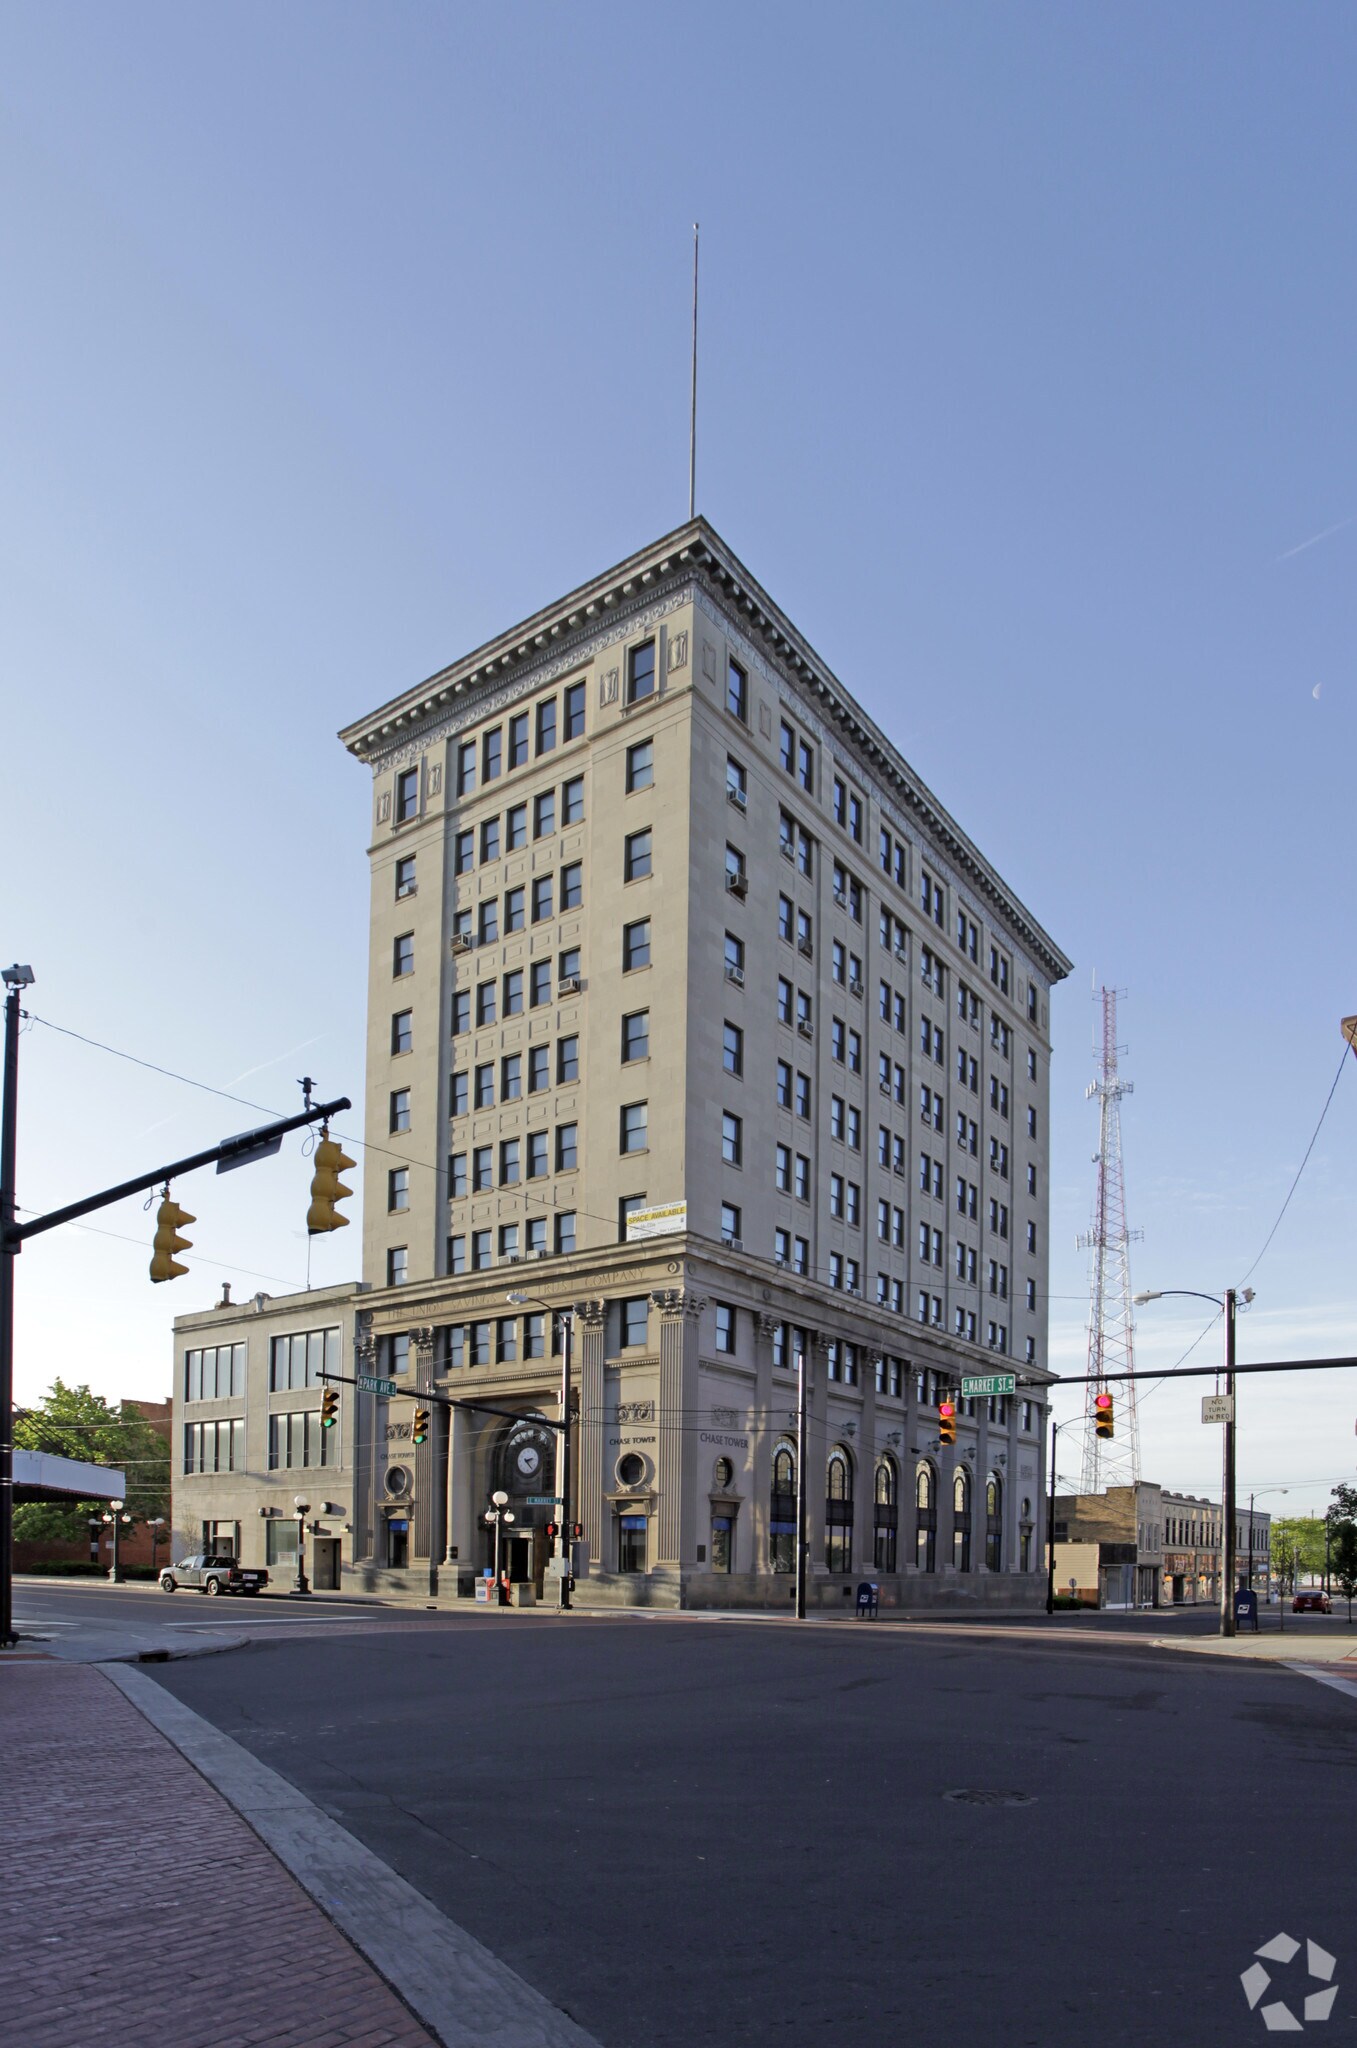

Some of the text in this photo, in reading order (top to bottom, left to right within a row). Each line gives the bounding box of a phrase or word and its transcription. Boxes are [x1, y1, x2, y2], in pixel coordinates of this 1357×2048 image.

[628, 1214, 649, 1225] SPACE
[650, 1206, 685, 1220] AVAILABLE
[412, 1303, 444, 1316] UNION
[452, 1295, 497, 1309] SAVINGS
[537, 1281, 575, 1295] TRUST
[585, 1268, 646, 1288] COMPANY
[363, 1377, 378, 1392] PARK
[968, 1378, 995, 1393] MARKET
[609, 1436, 656, 1446] CHASE TOWER
[700, 1432, 749, 1449] CHASE TOWER
[397, 1451, 415, 1459] TOWER
